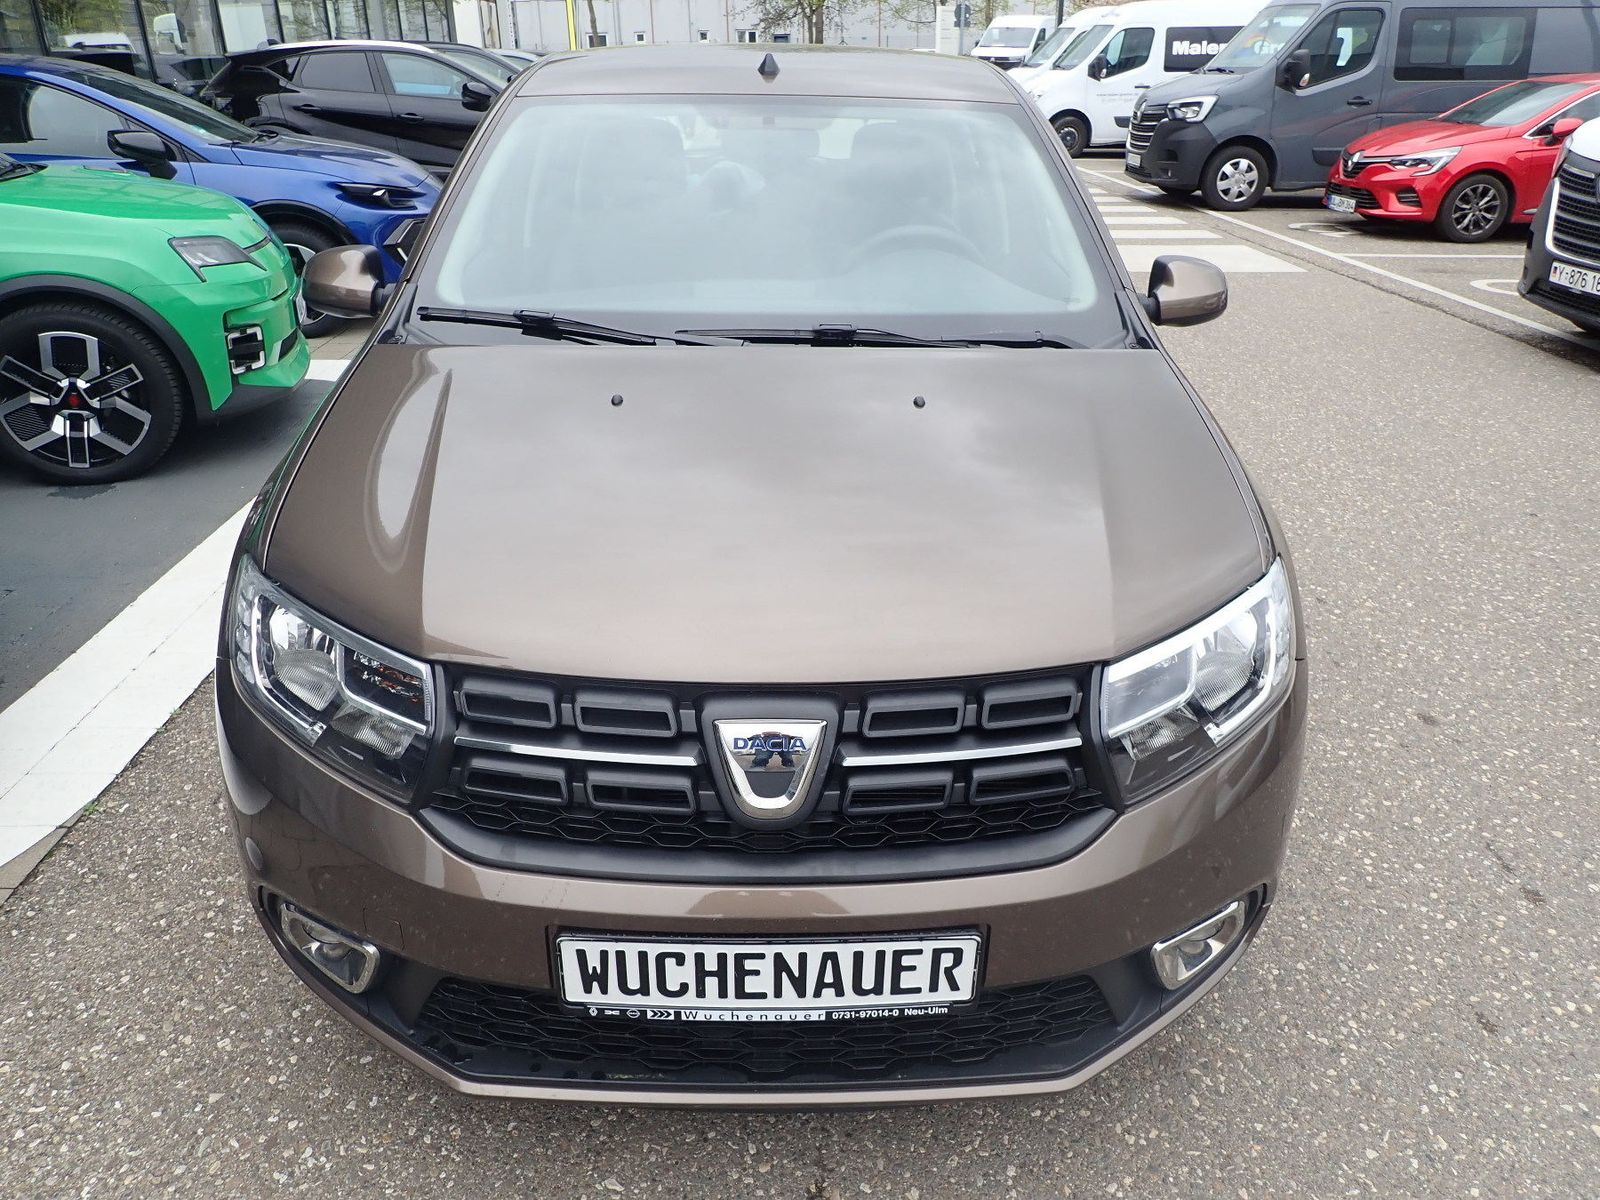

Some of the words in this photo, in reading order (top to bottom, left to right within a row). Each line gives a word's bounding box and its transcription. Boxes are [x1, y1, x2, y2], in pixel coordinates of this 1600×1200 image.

[733, 737, 809, 752] DACIA
[575, 947, 964, 1000] WUCHENAUER
[683, 1010, 824, 1021] Wuchenauer
[832, 1009, 900, 1020] 0731-97014-0
[904, 1006, 949, 1016] Neu-Ulm
